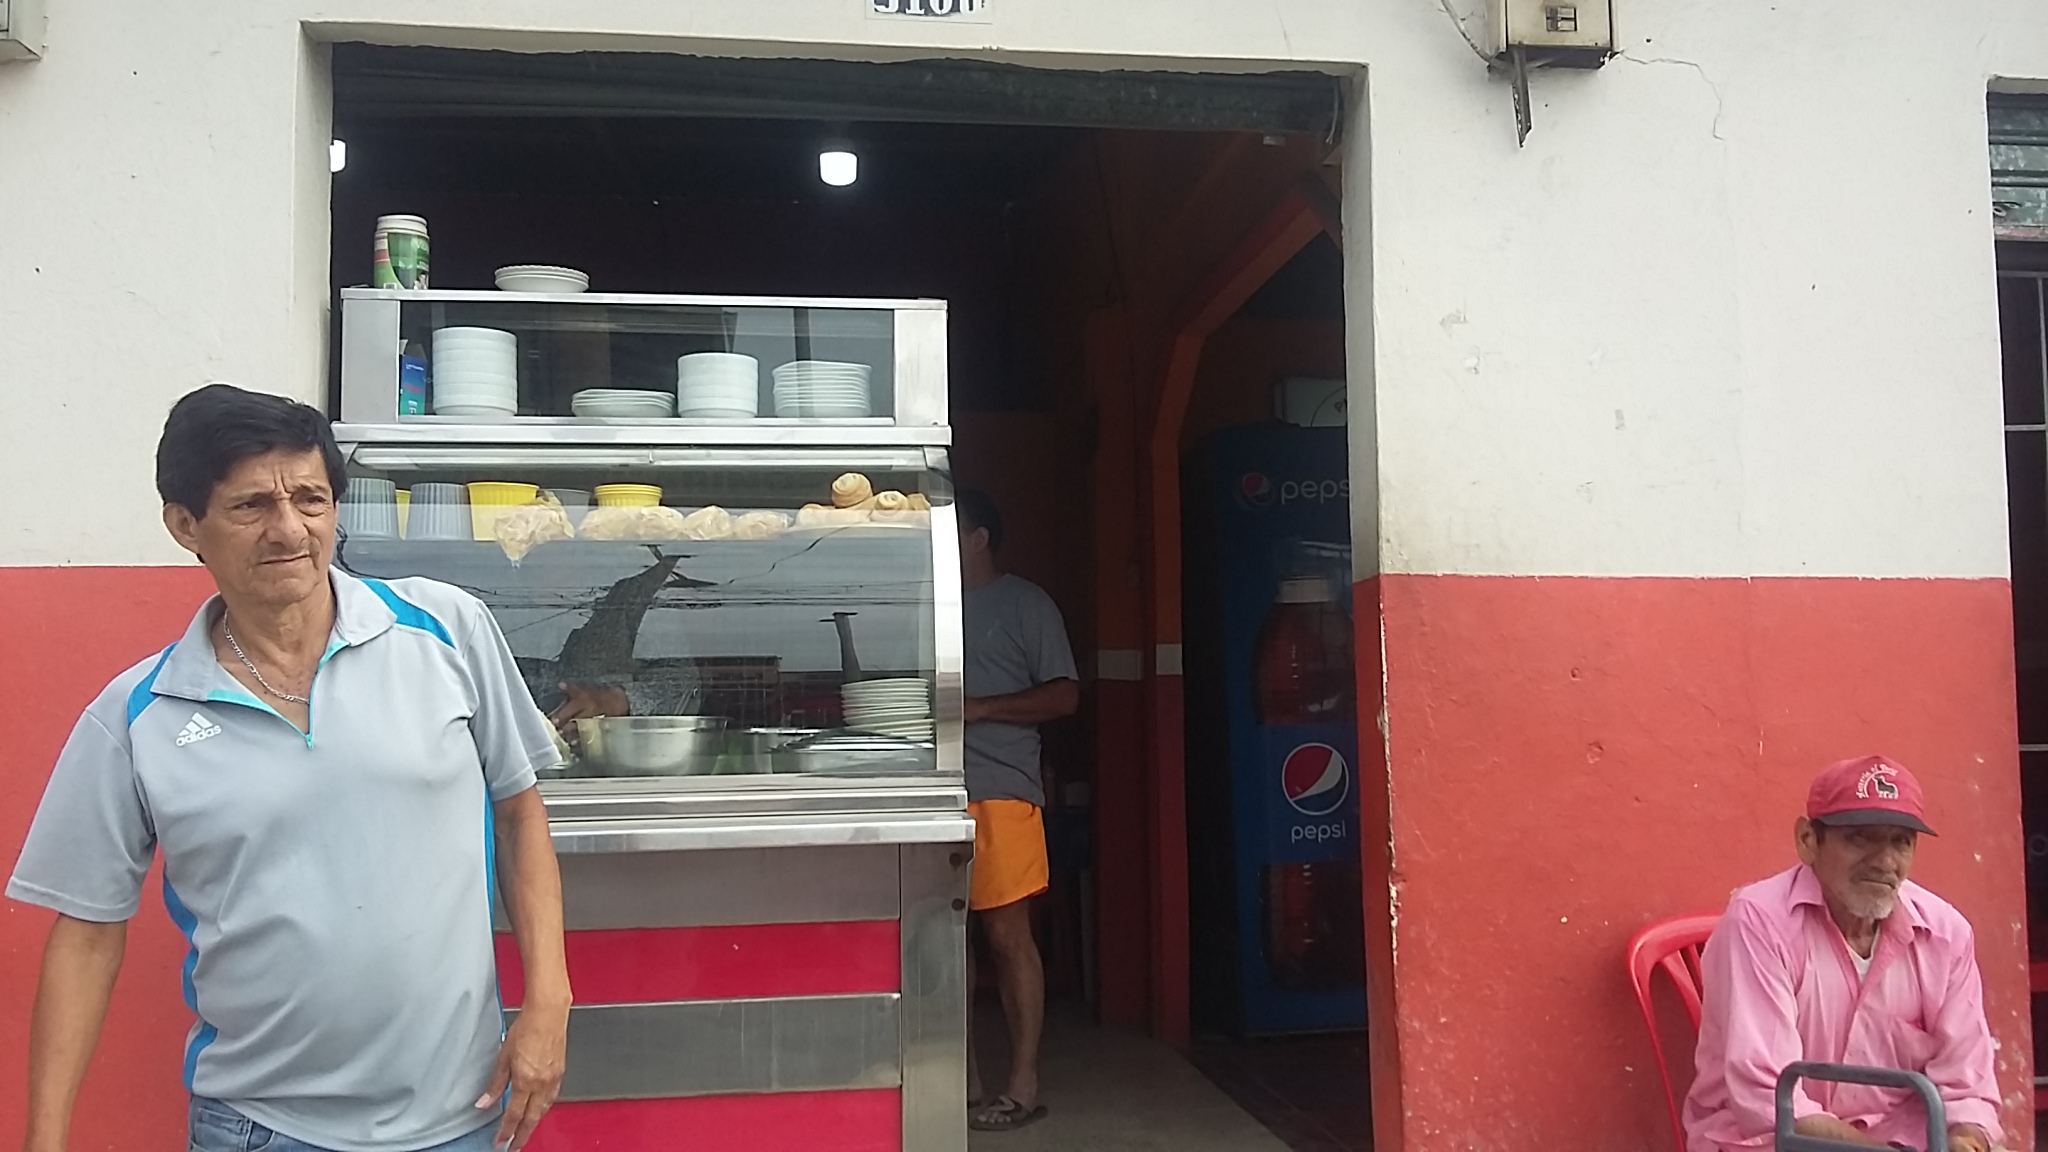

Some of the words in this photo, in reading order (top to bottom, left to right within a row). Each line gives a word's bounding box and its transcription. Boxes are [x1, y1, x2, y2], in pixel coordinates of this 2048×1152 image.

[1281, 479, 1349, 504] peps
[176, 725, 222, 747] adidas
[1291, 820, 1346, 843] pepsi
